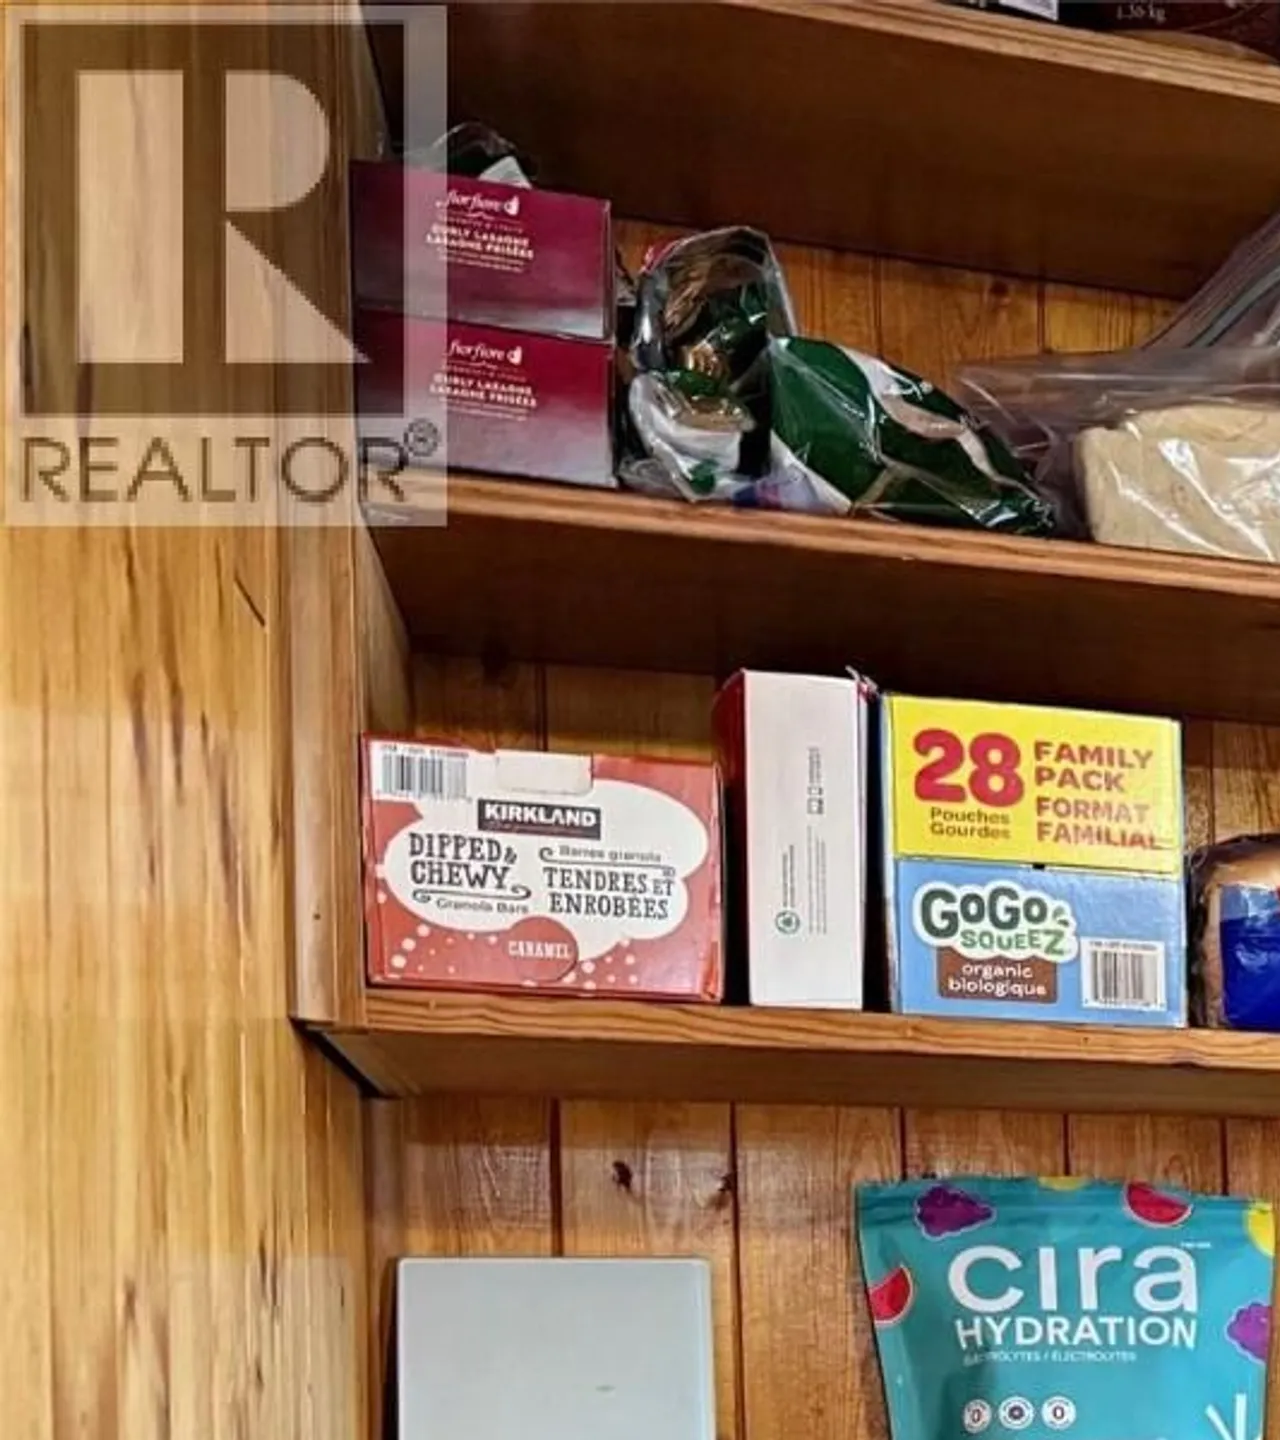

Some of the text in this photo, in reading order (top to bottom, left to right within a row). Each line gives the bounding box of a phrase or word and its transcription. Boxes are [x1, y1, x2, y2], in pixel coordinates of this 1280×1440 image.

[913, 727, 1025, 808] 28
[1034, 739, 1153, 769] FAMILY
[1034, 765, 1127, 794] PACK
[484, 803, 597, 828] KIRKLAND
[930, 807, 1011, 826] Pouches
[1036, 795, 1151, 825] FORMAT
[930, 822, 1012, 840] Gourdes
[1036, 821, 1163, 851] FAMILIAL
[408, 832, 502, 862] DIPPED
[410, 859, 511, 890] CHEWY
[543, 866, 675, 897] TENDRES ET
[436, 896, 529, 914] Granola Bars
[508, 940, 571, 959] CARAMEL
[961, 962, 1034, 982] organic
[948, 978, 1048, 999] biologique
[947, 1244, 1200, 1315] cira
[954, 1314, 1198, 1351] HYDRATION
